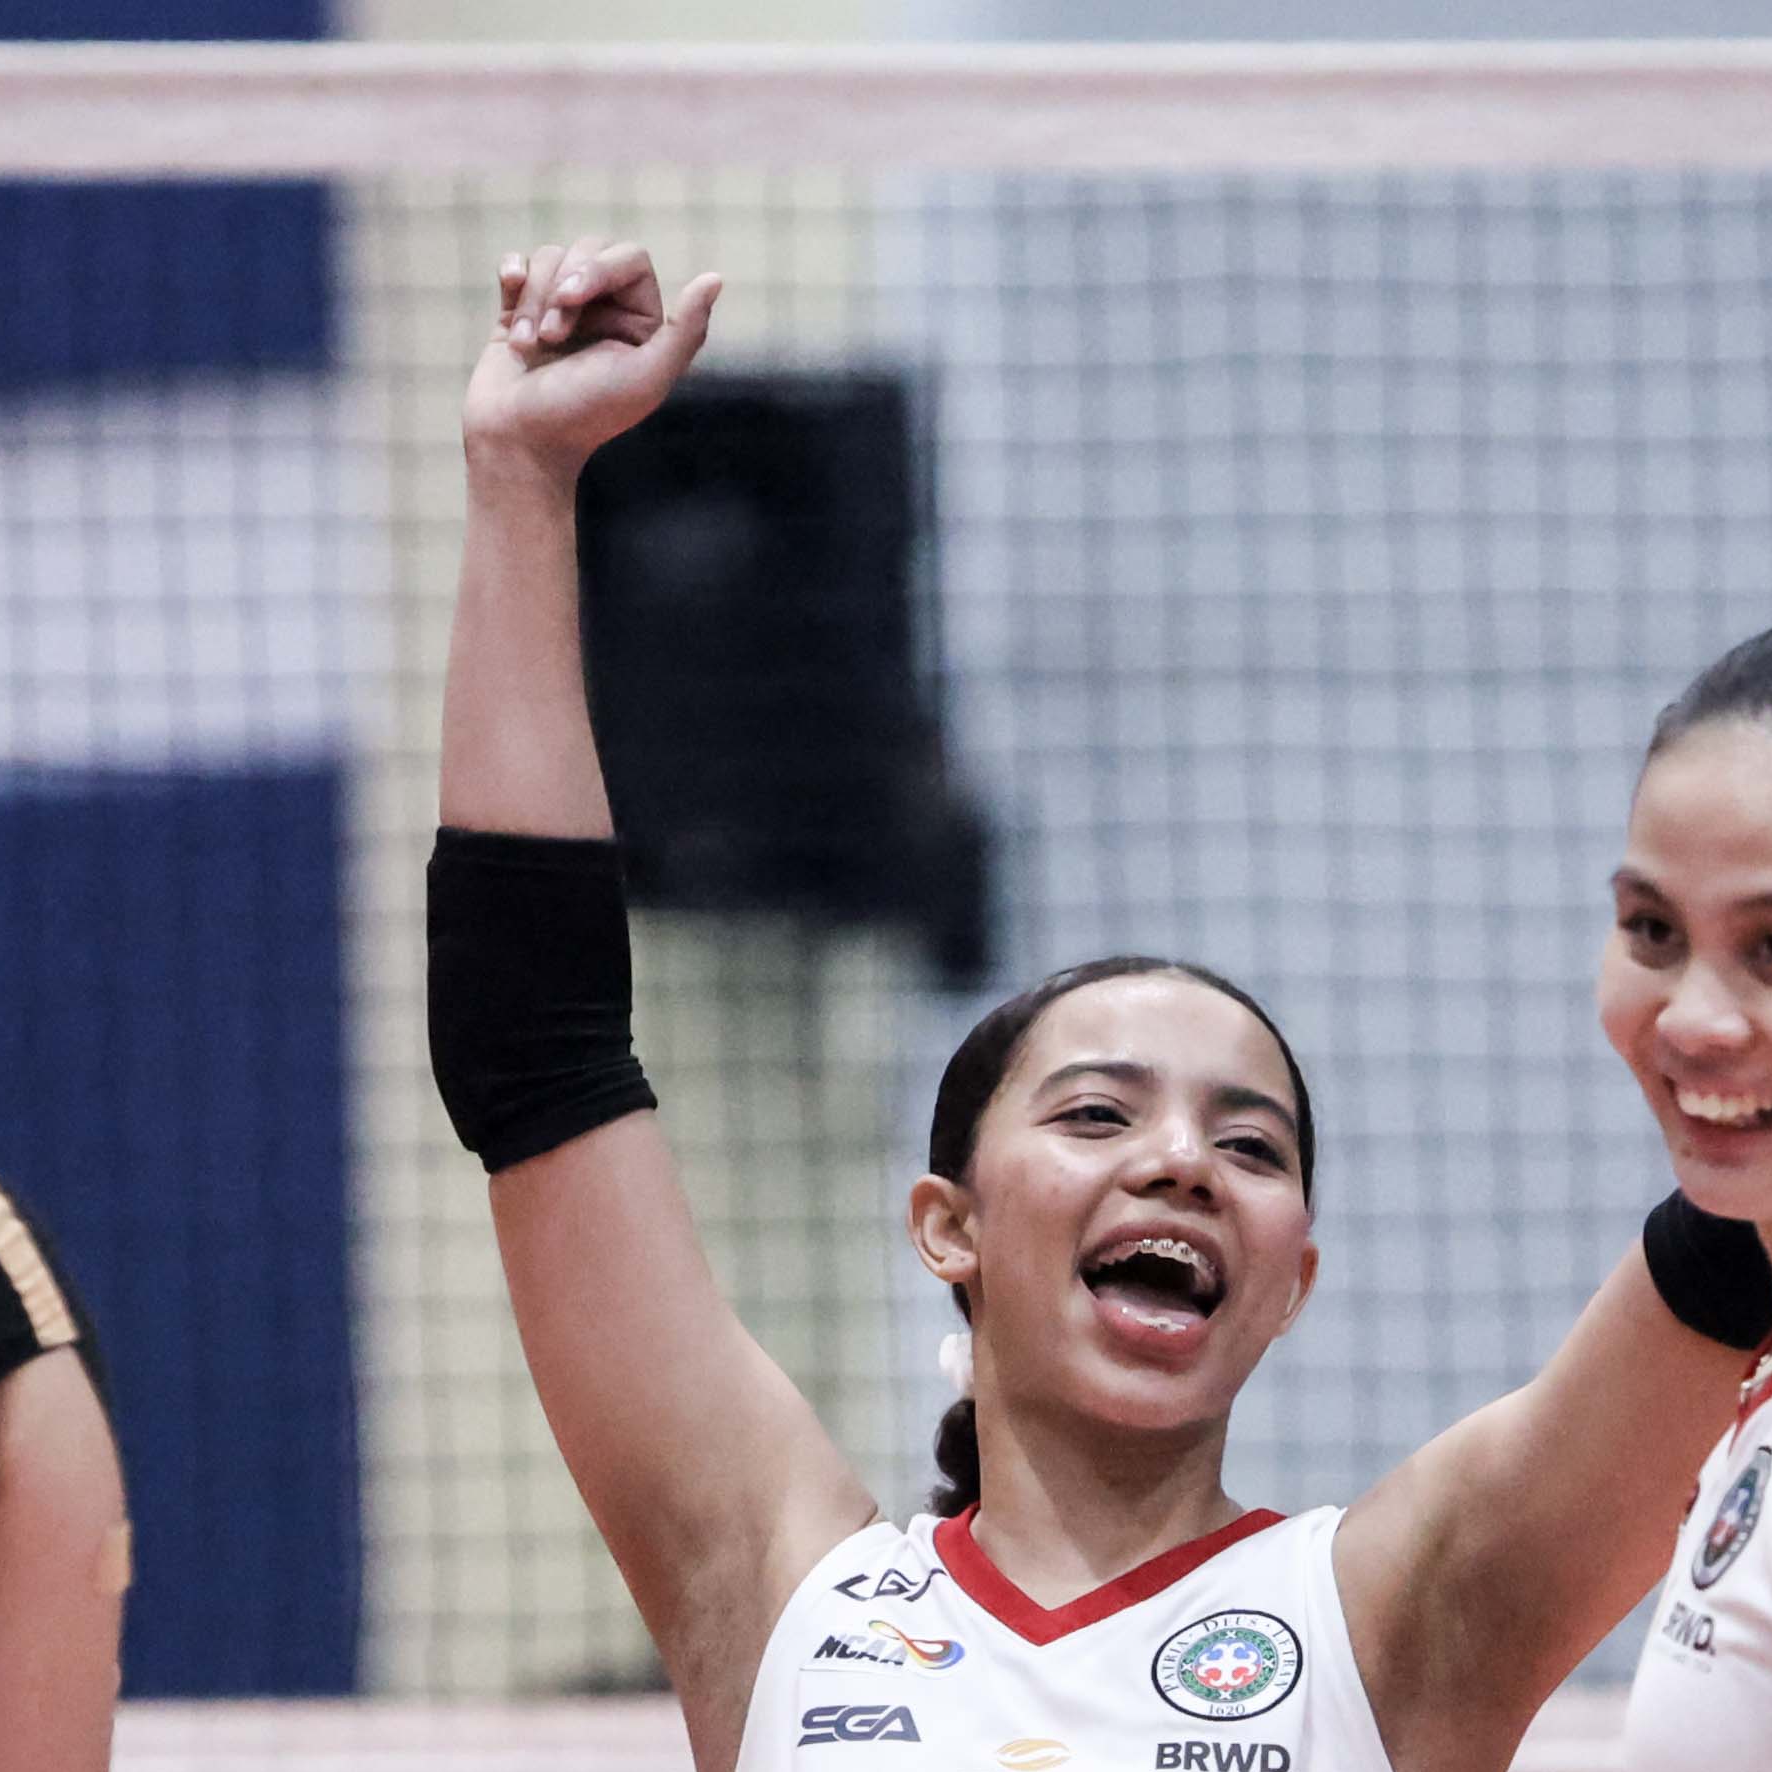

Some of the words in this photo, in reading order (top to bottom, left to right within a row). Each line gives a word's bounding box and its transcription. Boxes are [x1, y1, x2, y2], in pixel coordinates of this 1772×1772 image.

[813, 1632, 908, 1666] NCAA
[796, 1704, 921, 1747] SGA
[1208, 1704, 1246, 1716] 1620
